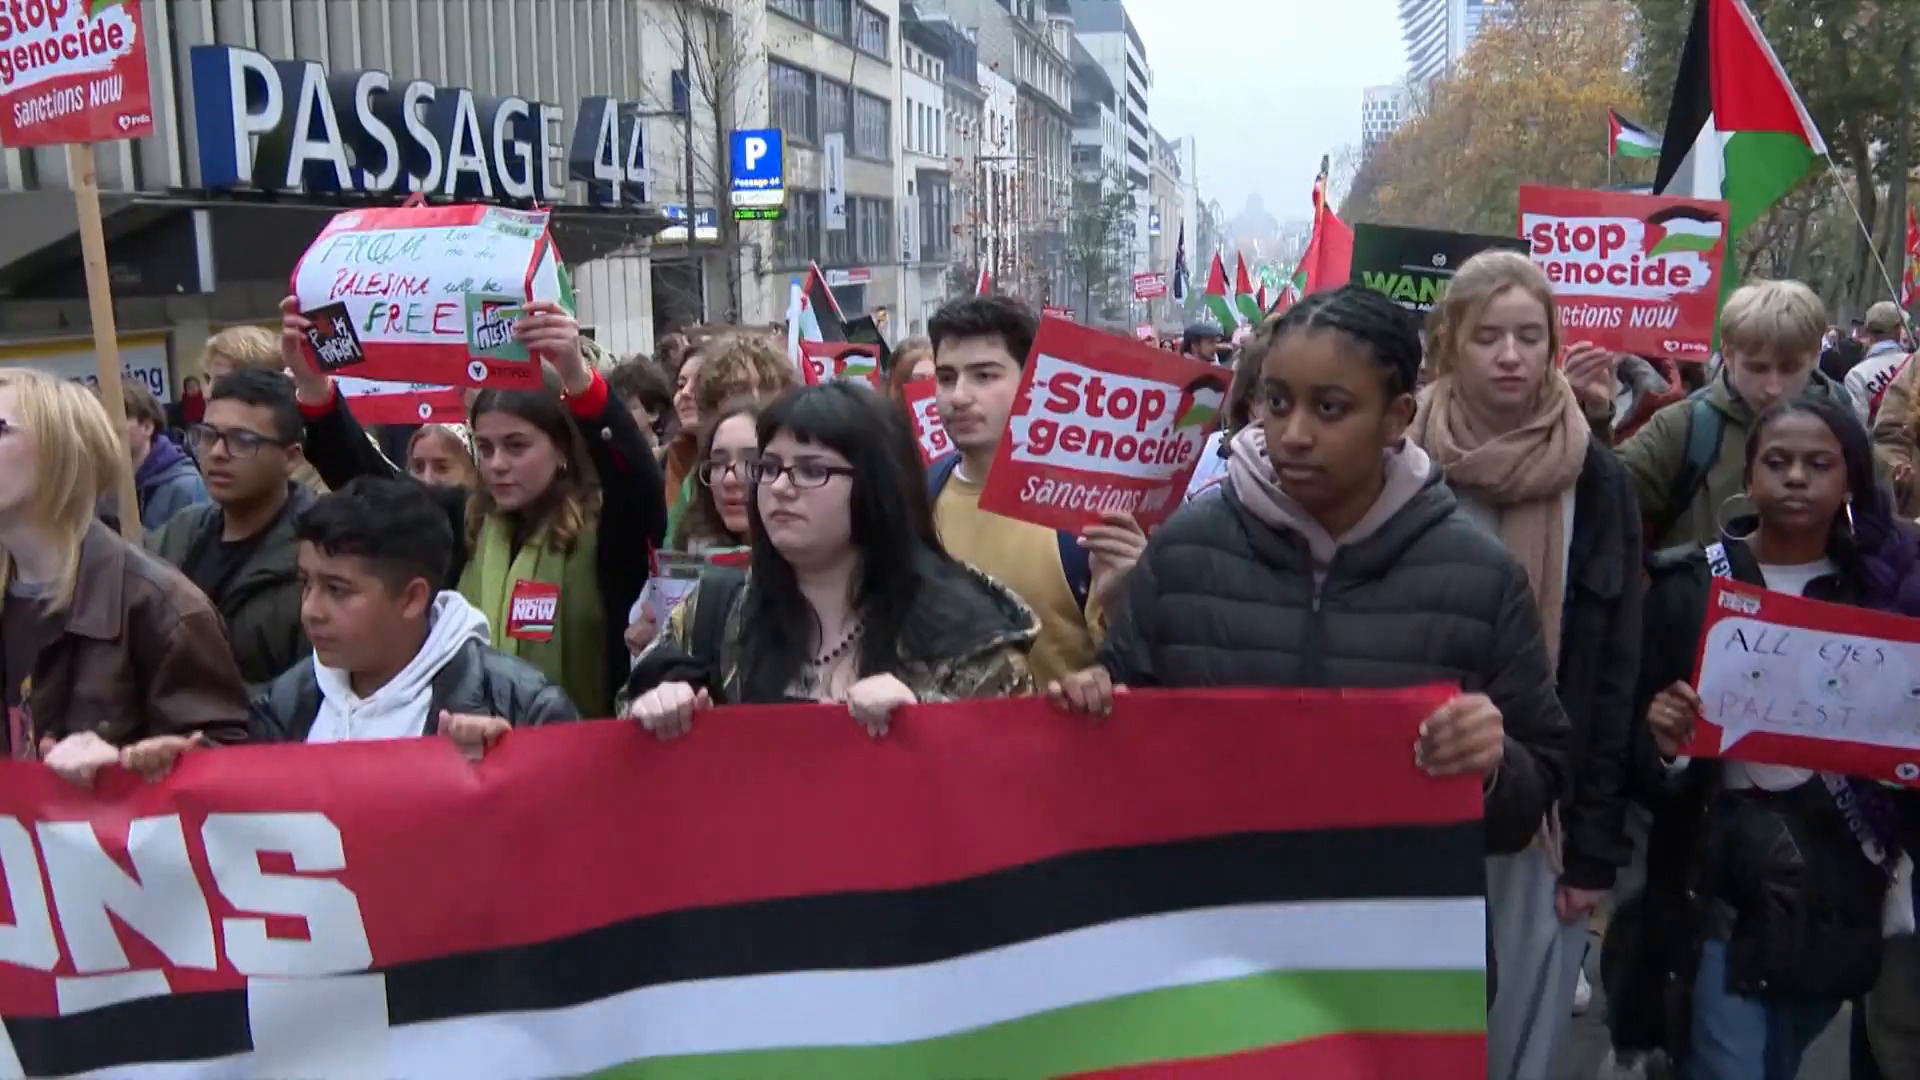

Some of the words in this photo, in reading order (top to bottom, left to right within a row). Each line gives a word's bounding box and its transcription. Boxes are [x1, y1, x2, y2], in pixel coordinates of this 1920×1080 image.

[0, 18, 123, 85] genocide
[14, 85, 83, 128] sanctions
[89, 74, 122, 107] NOW
[229, 48, 566, 199] PASSAGE
[594, 96, 653, 208] 44
[745, 136, 767, 170] P
[734, 178, 769, 188] Passage
[769, 176, 780, 187] 44
[1151, 215, 1159, 226] P
[1532, 222, 1626, 259] Stop
[1363, 271, 1451, 304] WAN
[364, 302, 464, 334] FREE
[1558, 303, 1624, 329] ctions
[1629, 304, 1680, 329] NOW
[1044, 372, 1166, 431] Stop
[1027, 418, 1193, 464] genocide
[1020, 475, 1142, 513] sanctions
[512, 597, 558, 621] NOW
[1724, 626, 1790, 656] ALL
[1818, 640, 1886, 671] EYES
